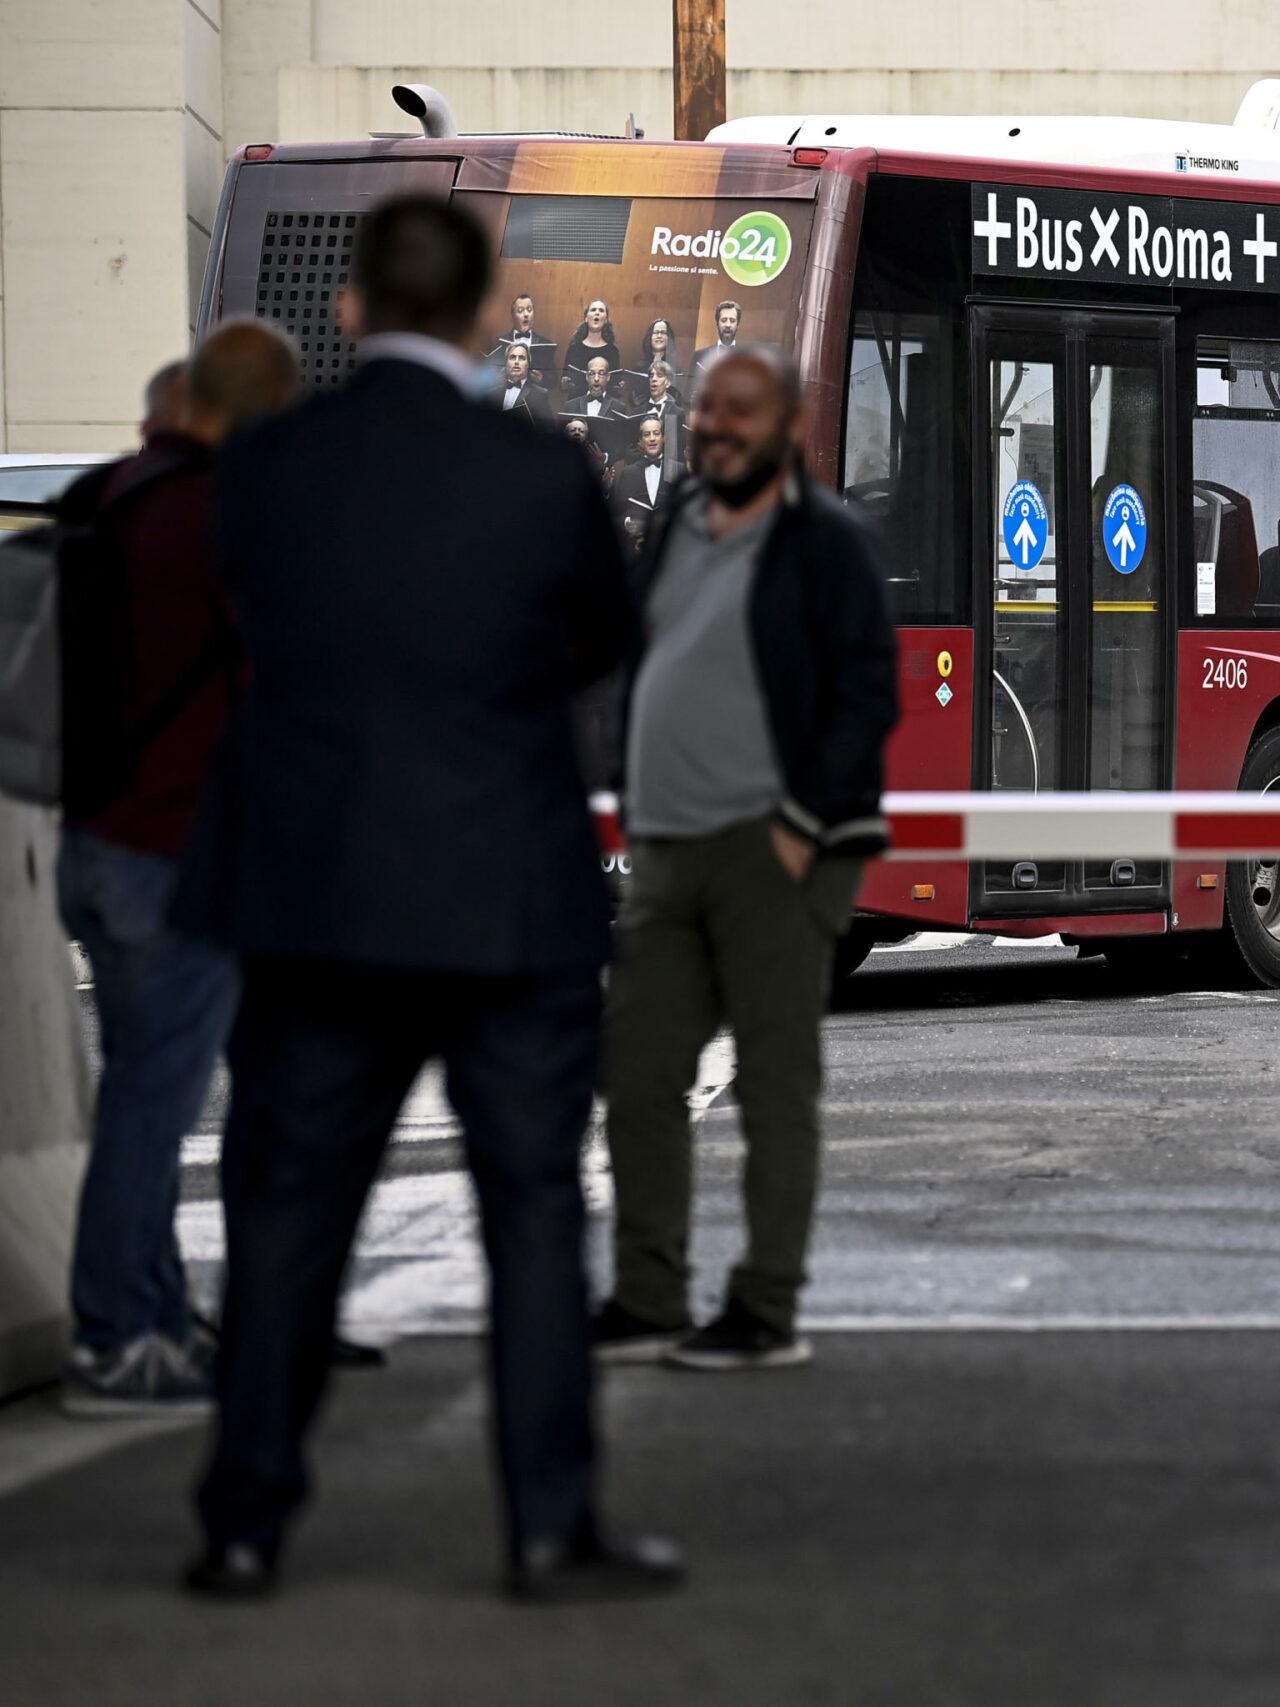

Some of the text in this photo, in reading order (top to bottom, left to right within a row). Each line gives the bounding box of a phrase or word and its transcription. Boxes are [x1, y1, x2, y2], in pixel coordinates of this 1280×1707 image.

[1188, 156, 1221, 170] THERMO
[1221, 159, 1239, 172] KING
[650, 226, 778, 269] Radio24
[659, 265, 690, 274] passione
[690, 266, 697, 274] si
[1202, 658, 1248, 689] 2406
